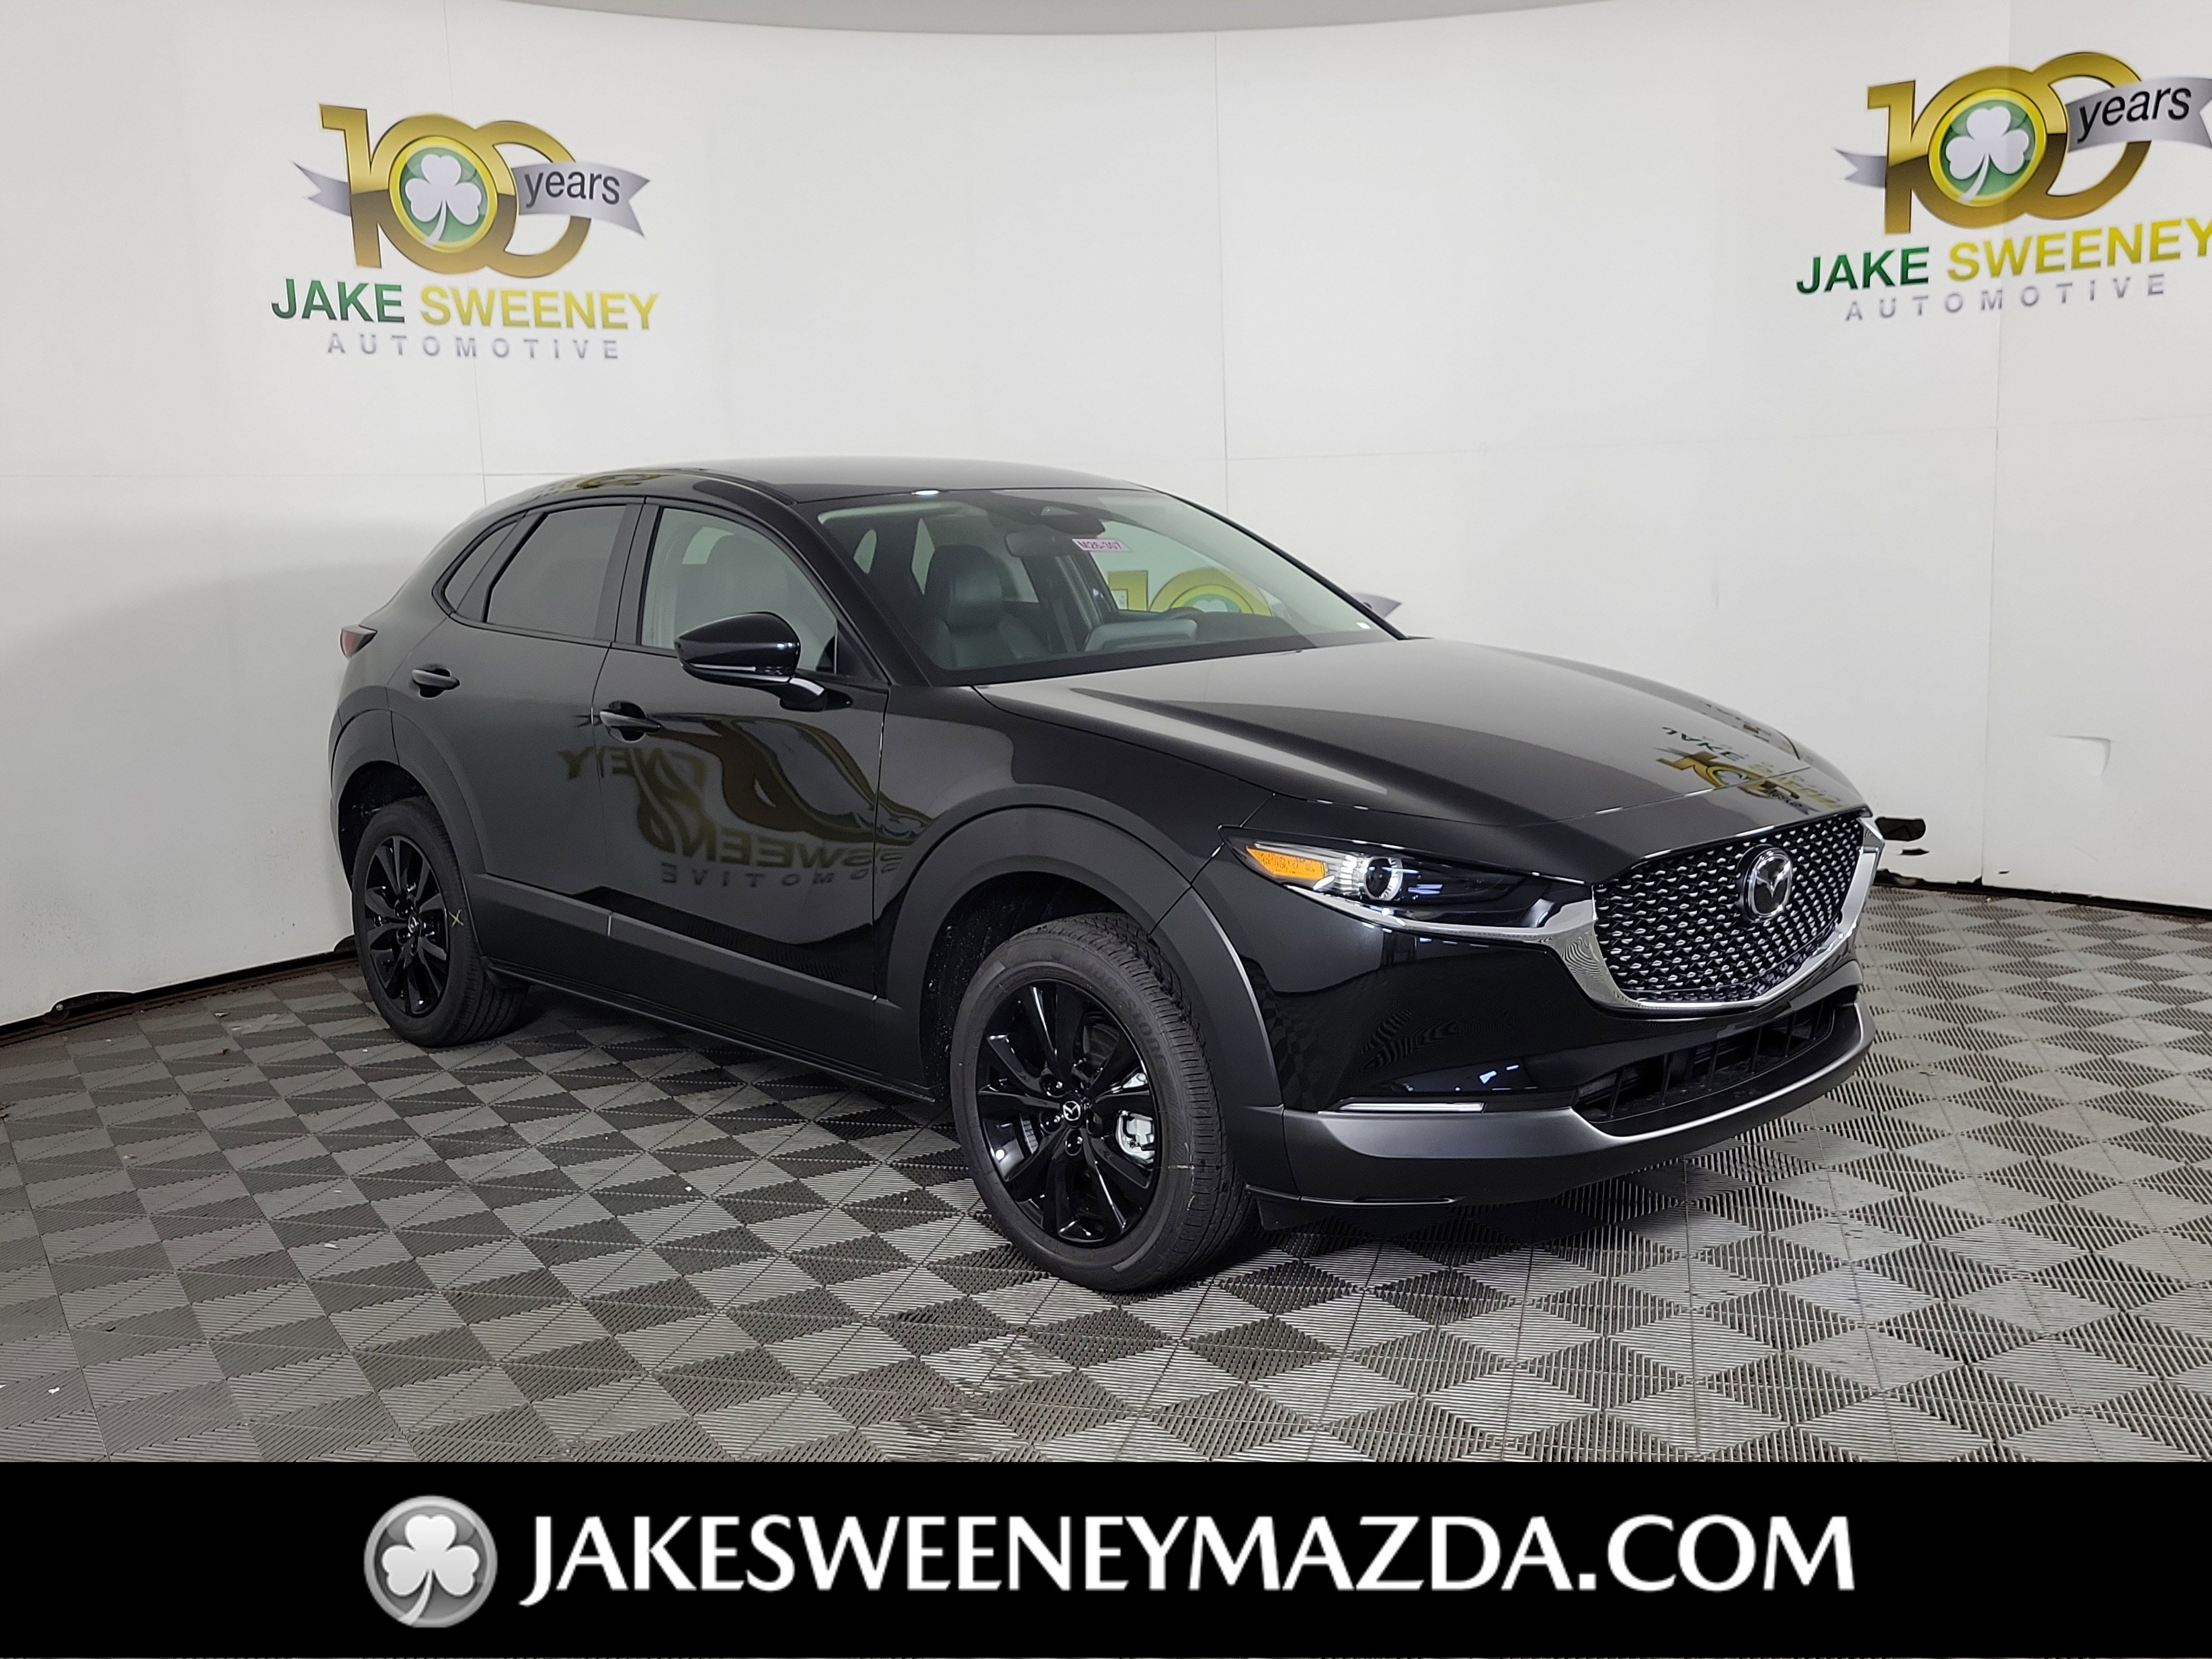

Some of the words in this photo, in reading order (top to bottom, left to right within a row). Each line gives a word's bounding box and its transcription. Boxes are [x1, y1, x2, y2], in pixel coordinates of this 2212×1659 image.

[2076, 86, 2192, 142] years
[1866, 51, 2152, 235] 100
[319, 103, 592, 278] 100
[524, 171, 620, 207] years
[1796, 246, 1929, 294] JAKE
[1946, 217, 2212, 281] SWEENEY
[272, 278, 405, 323] JAKE
[420, 285, 658, 329] SWEENEY
[1844, 274, 2164, 321] AUTOMOTIVE
[328, 332, 618, 359] AUTOMOTIVE
